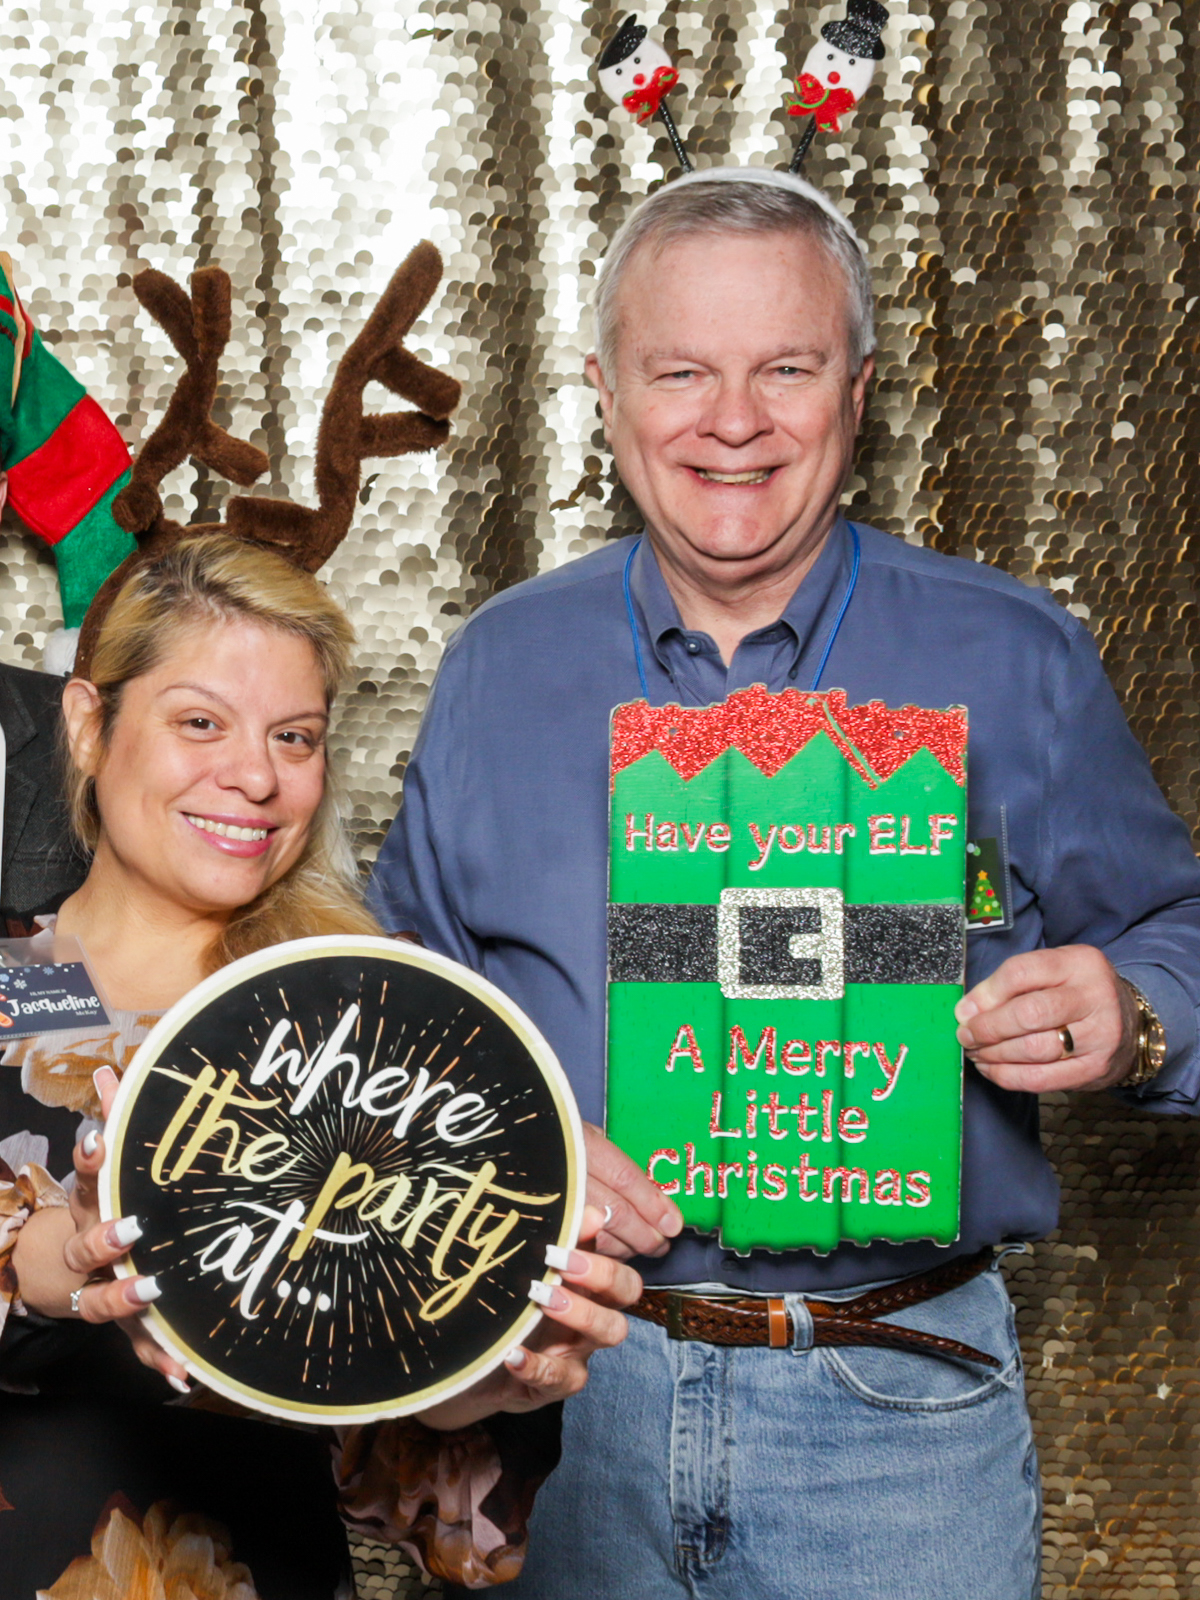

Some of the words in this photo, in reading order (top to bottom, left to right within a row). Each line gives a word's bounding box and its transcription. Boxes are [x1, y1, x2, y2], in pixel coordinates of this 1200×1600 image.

[624, 811, 732, 854] Have
[748, 821, 856, 870] your
[867, 812, 958, 856] ELF
[6, 994, 100, 1017] Jacqueline
[249, 1003, 499, 1143] where
[665, 1023, 705, 1073] A
[726, 1024, 909, 1101] Merry
[708, 1089, 870, 1143] Little
[150, 1064, 303, 1187] the
[288, 1151, 562, 1322] party
[646, 1141, 932, 1208] Christmas
